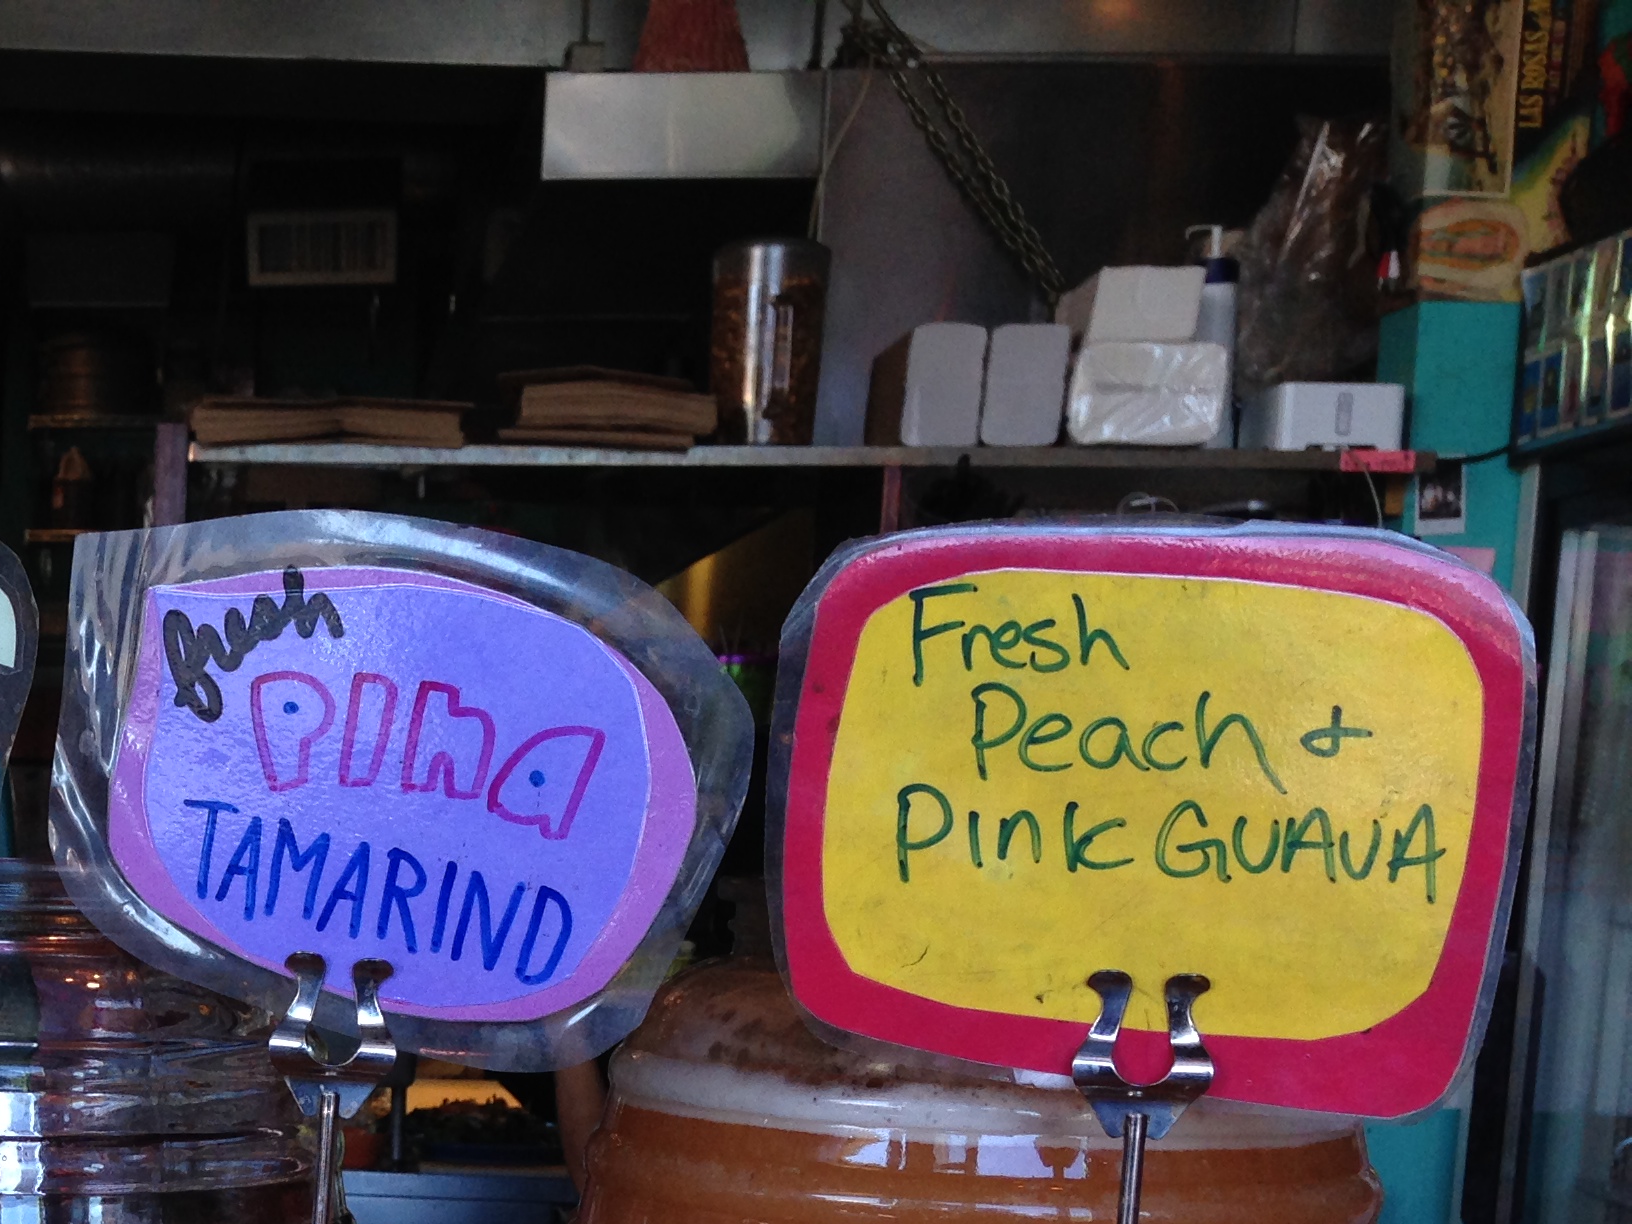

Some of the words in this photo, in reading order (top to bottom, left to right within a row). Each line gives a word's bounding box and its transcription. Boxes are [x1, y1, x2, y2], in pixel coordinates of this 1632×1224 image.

[909, 583, 1131, 686] Fresh
[970, 681, 1288, 796] Peach
[182, 798, 575, 986] TAMARIND
[1155, 799, 1448, 905] GUAVA
